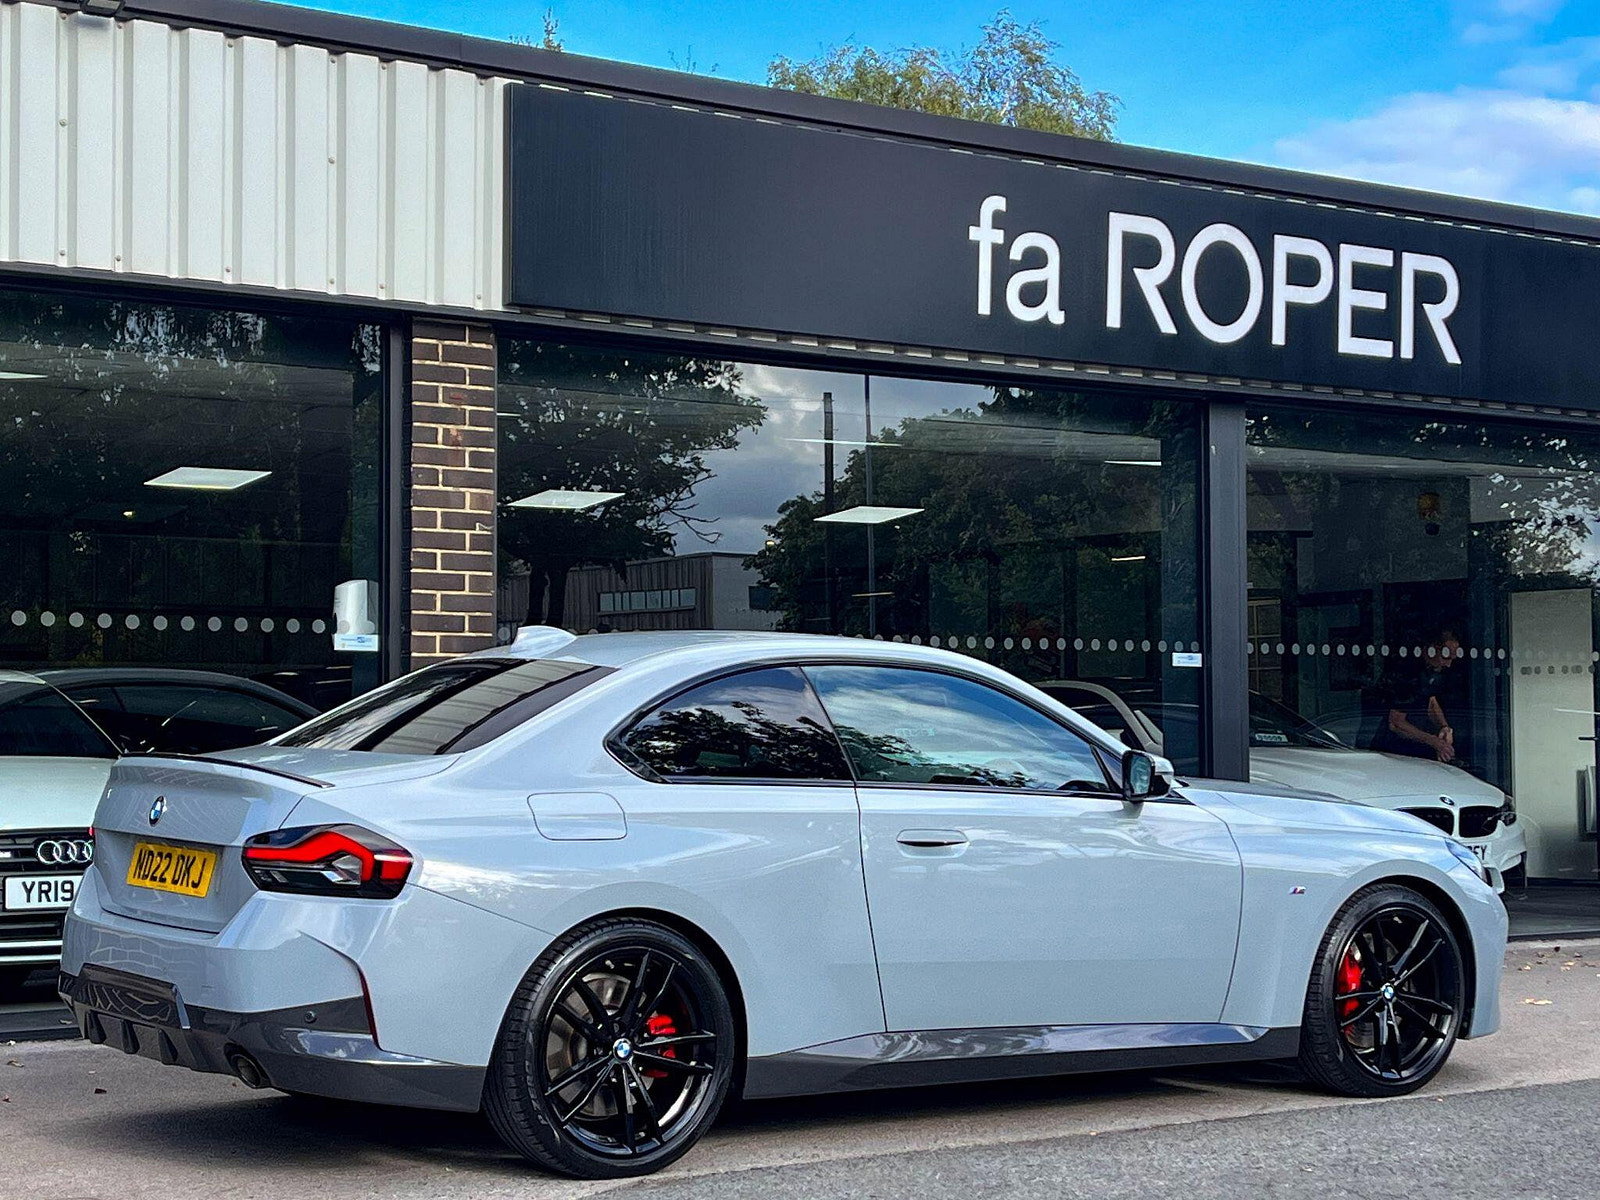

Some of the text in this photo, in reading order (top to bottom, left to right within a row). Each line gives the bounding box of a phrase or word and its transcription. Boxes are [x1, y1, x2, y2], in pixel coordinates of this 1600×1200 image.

[969, 195, 1462, 365] fa ROPER
[133, 848, 207, 889] ND22 DKJ
[21, 880, 75, 903] YR19
